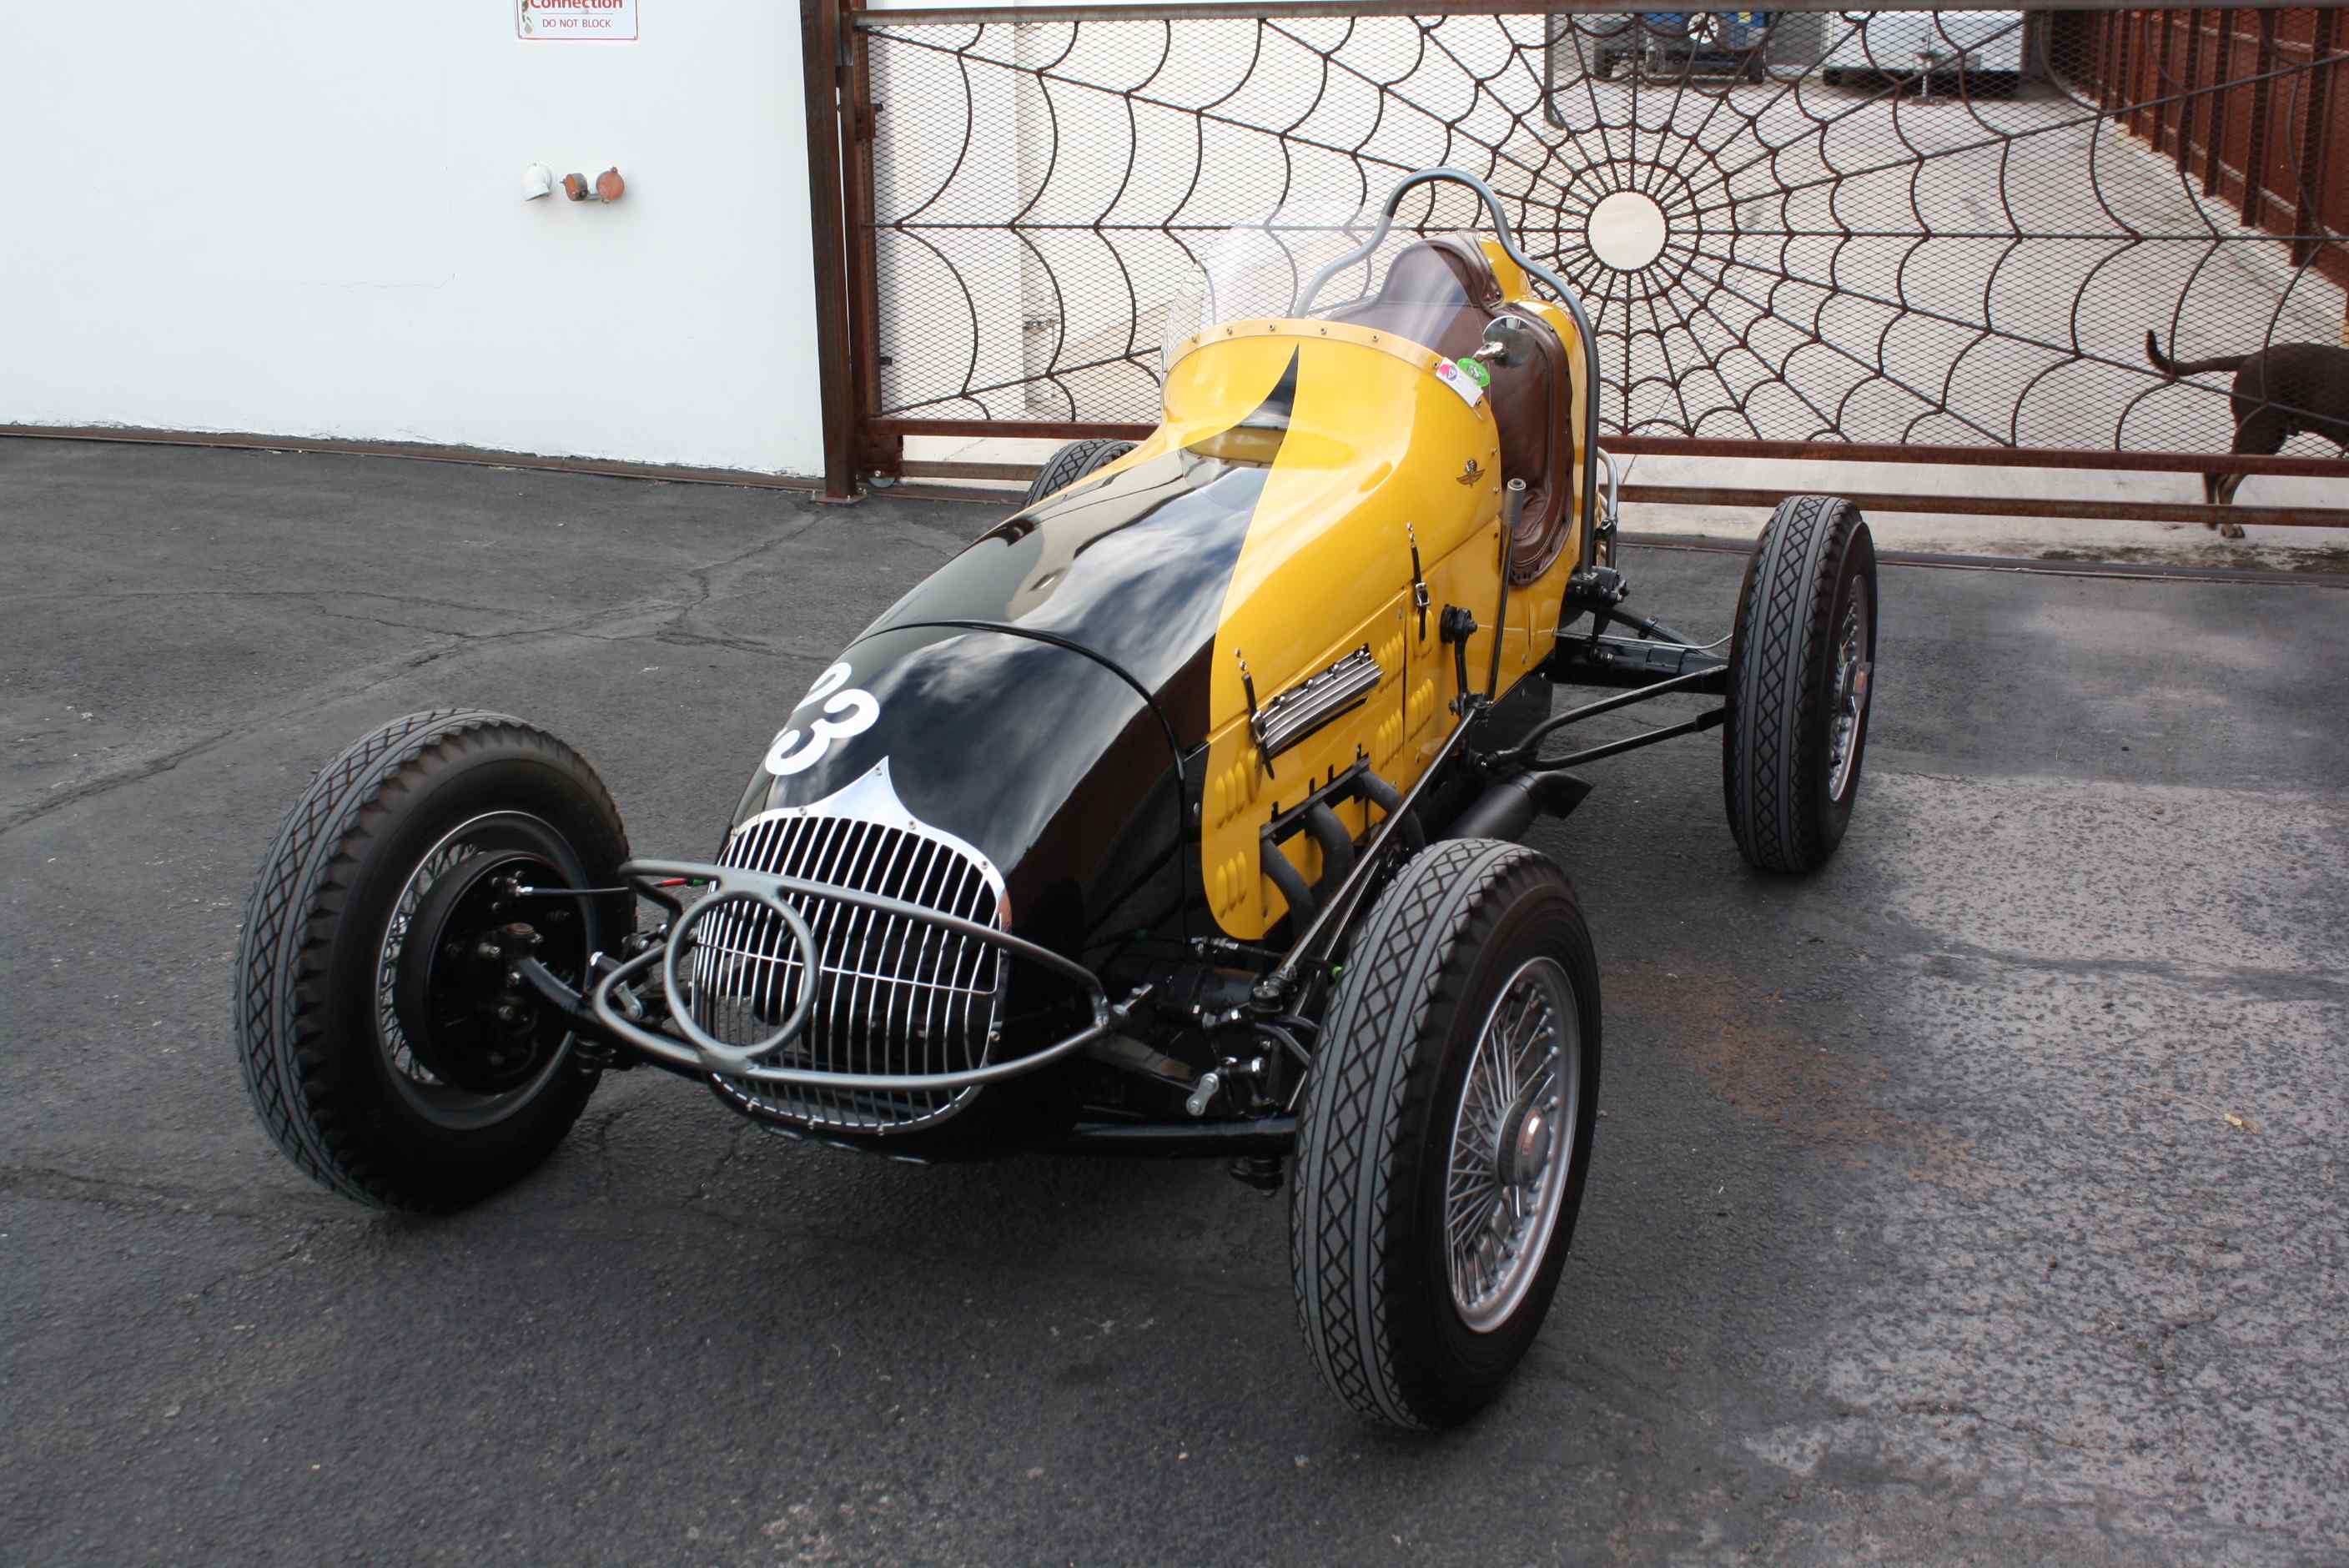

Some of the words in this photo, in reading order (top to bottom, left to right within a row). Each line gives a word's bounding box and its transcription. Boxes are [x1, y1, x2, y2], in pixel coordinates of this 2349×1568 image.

[530, 0, 623, 8] Connection
[542, 18, 556, 28] DO
[560, 18, 579, 28] NOT
[582, 18, 611, 28] BLOCK
